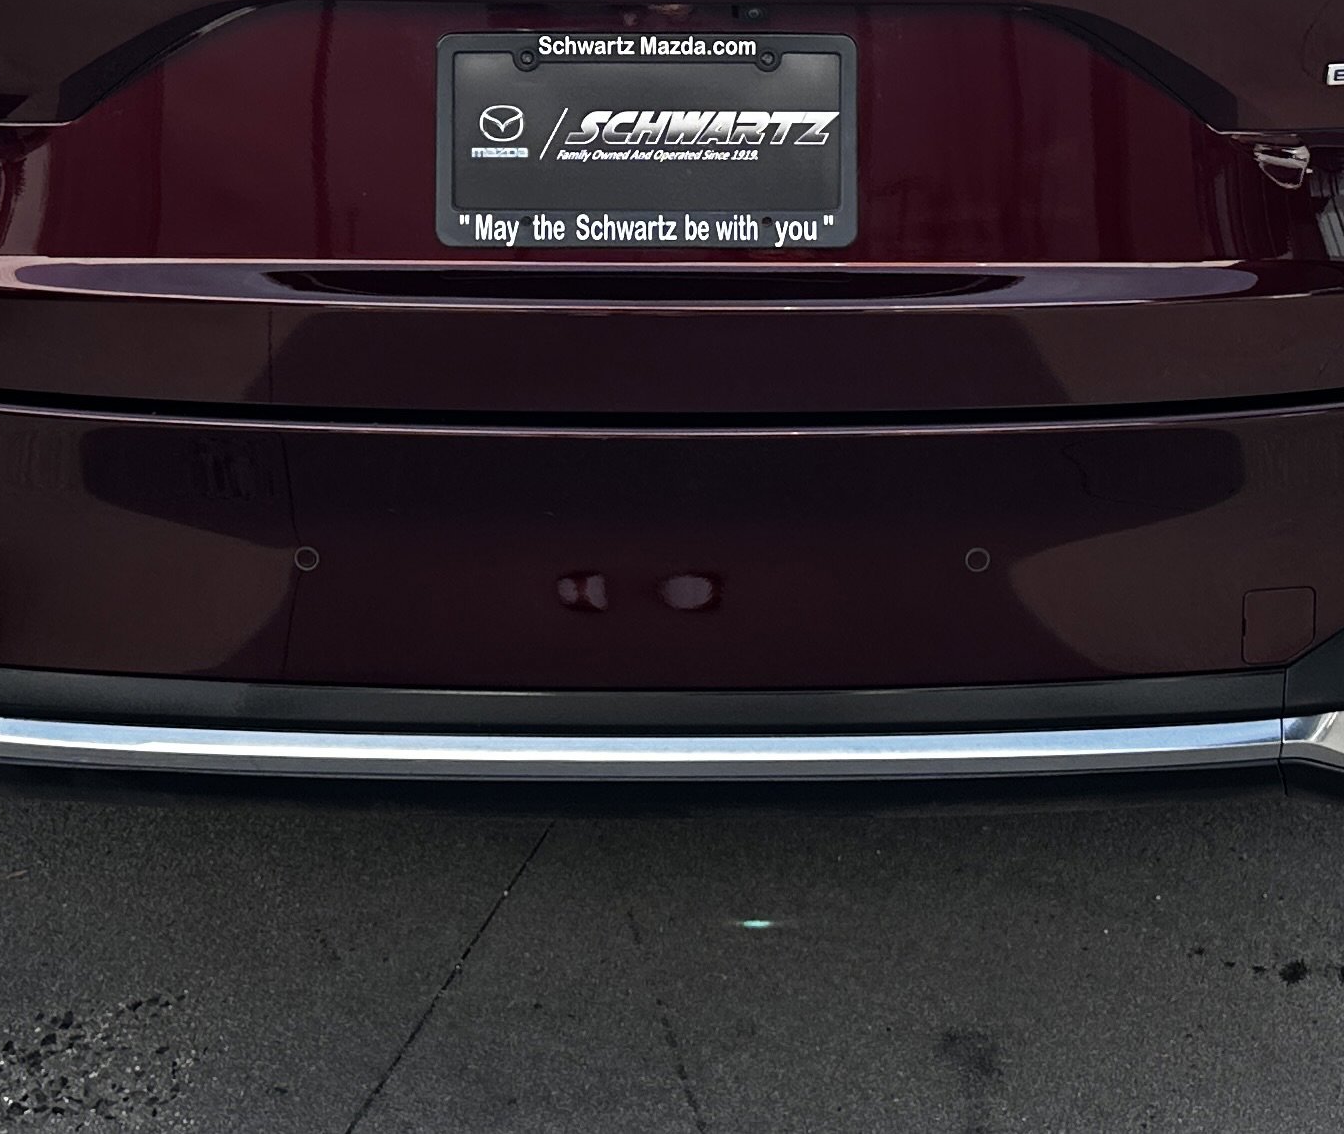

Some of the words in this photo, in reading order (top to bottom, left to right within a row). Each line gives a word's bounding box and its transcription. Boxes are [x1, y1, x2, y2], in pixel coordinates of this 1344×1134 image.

[538, 35, 635, 56] Schwartz
[640, 35, 757, 56] Mazda.com
[564, 110, 841, 146] SCHWARTZ
[556, 149, 592, 162] Family
[592, 149, 629, 161] Owned
[630, 150, 655, 161] And
[654, 149, 703, 162] Operated
[702, 149, 731, 161] Since
[475, 216, 520, 247] May
[532, 214, 566, 241] the
[575, 214, 678, 241] Schwartz
[684, 214, 710, 241] be
[715, 215, 759, 241] with
[774, 219, 818, 247] you
